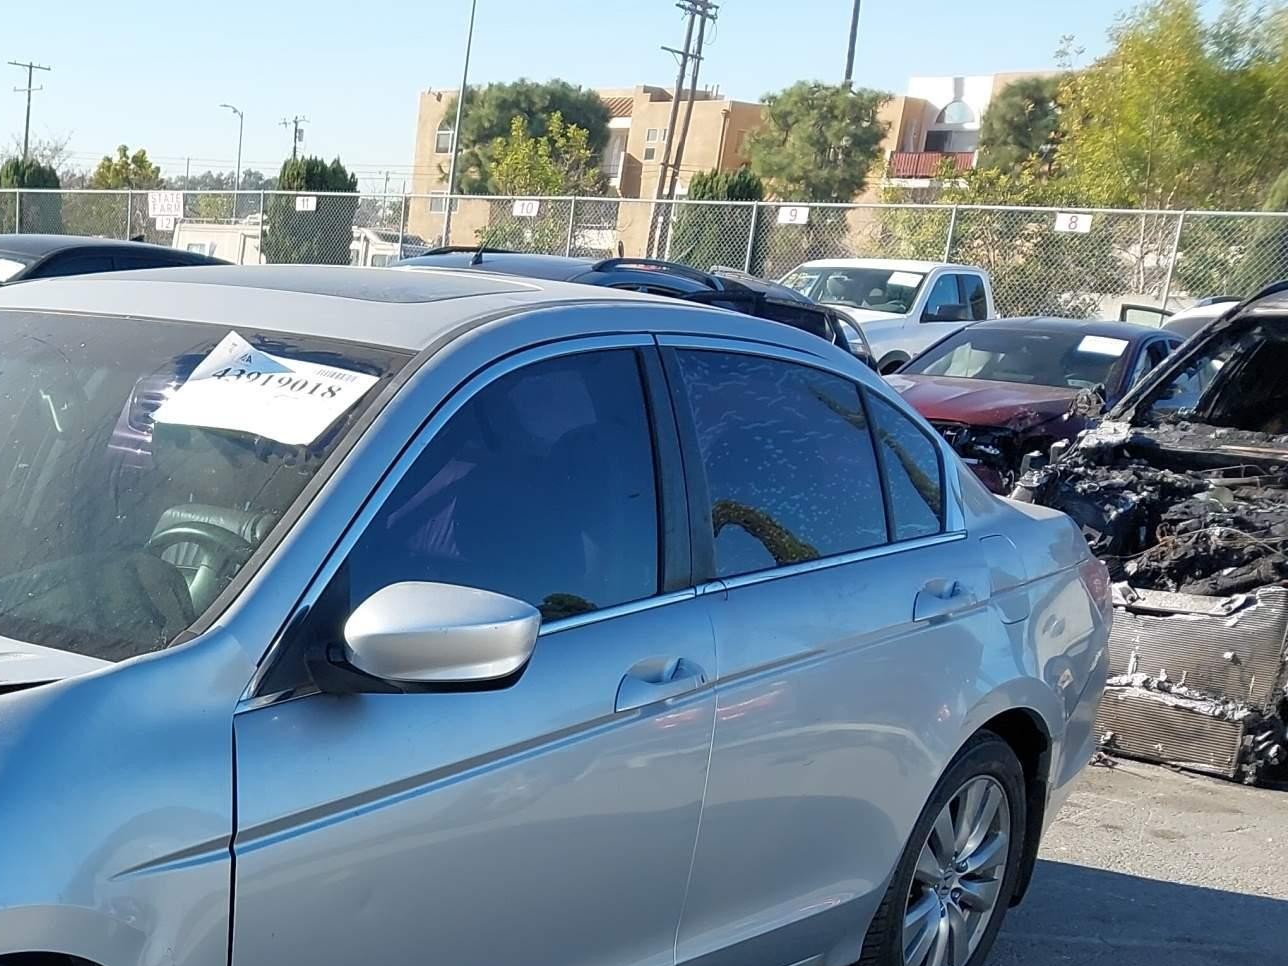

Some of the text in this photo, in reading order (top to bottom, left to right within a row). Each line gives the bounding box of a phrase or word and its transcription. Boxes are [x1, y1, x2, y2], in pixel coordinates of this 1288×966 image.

[151, 192, 181, 203] STATE
[151, 203, 181, 213] FARM
[520, 202, 534, 215] 10
[788, 208, 798, 222] 9
[159, 217, 172, 229] 12
[1067, 215, 1079, 230] 8
